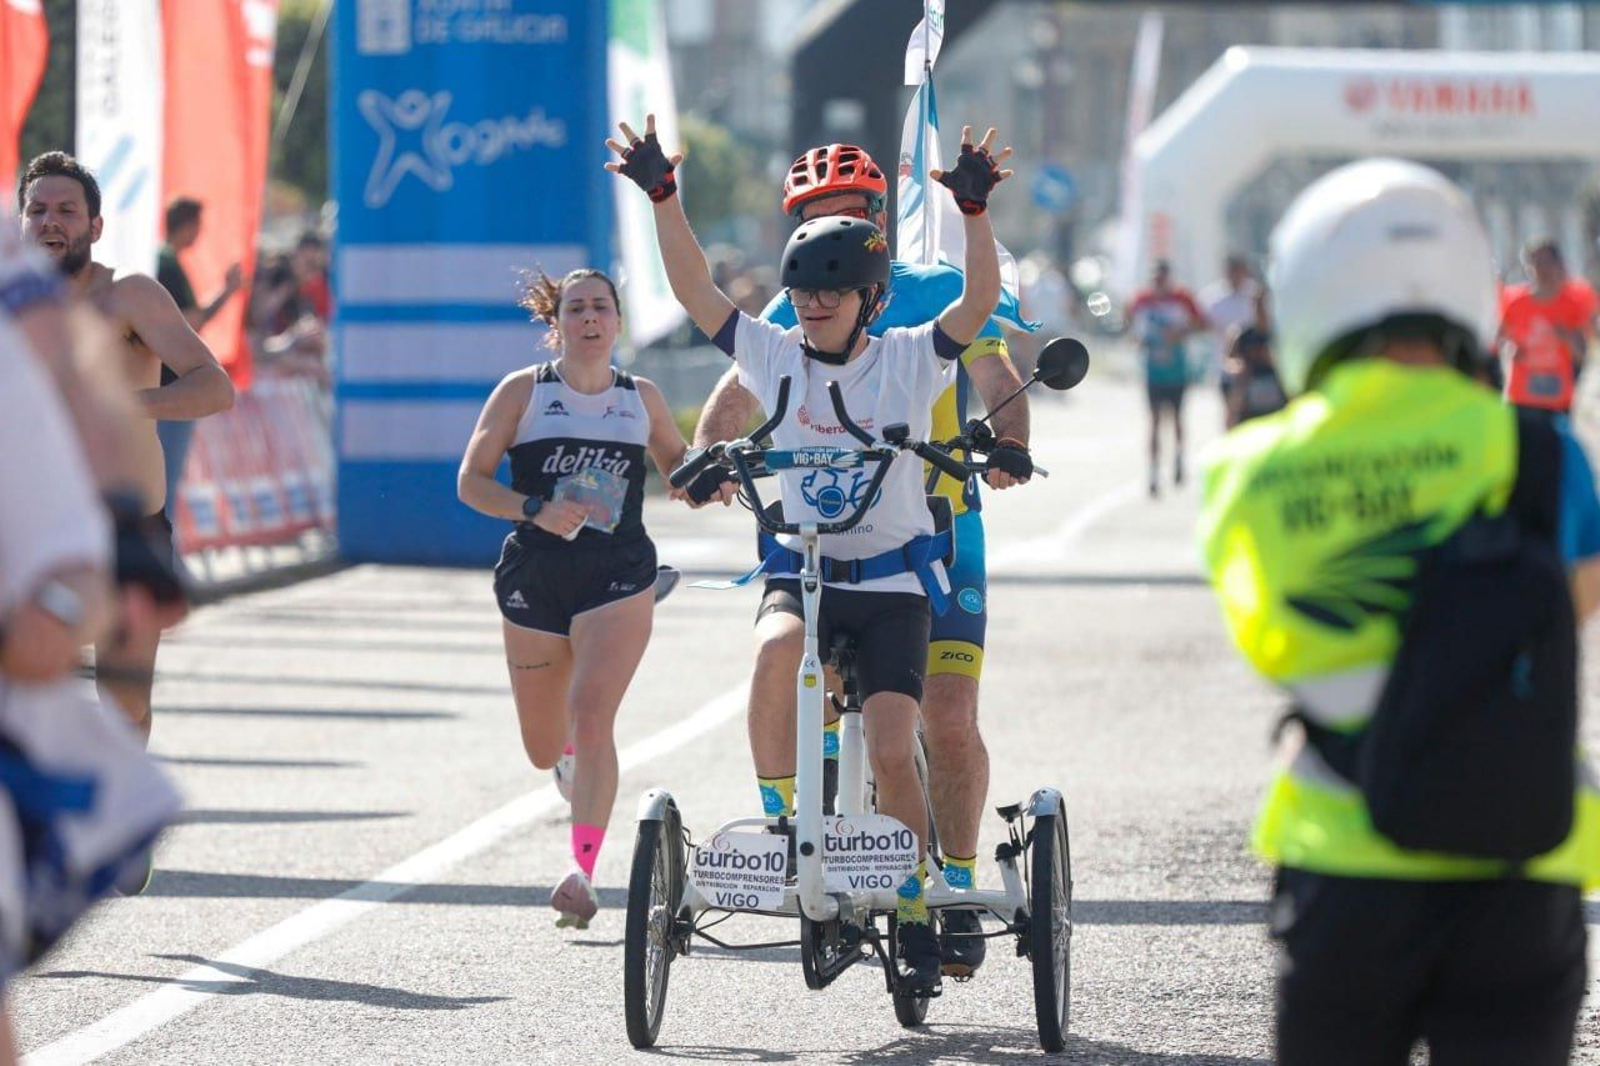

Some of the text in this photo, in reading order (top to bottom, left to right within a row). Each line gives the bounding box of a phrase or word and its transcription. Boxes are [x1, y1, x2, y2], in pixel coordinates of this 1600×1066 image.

[940, 651, 974, 663] ZICO
[825, 829, 913, 852] turbo10
[695, 846, 785, 872] turbo10
[693, 870, 785, 885] TURBOCOMPRENSORES
[848, 875, 893, 889] VIGO
[716, 891, 760, 908] VIGO
